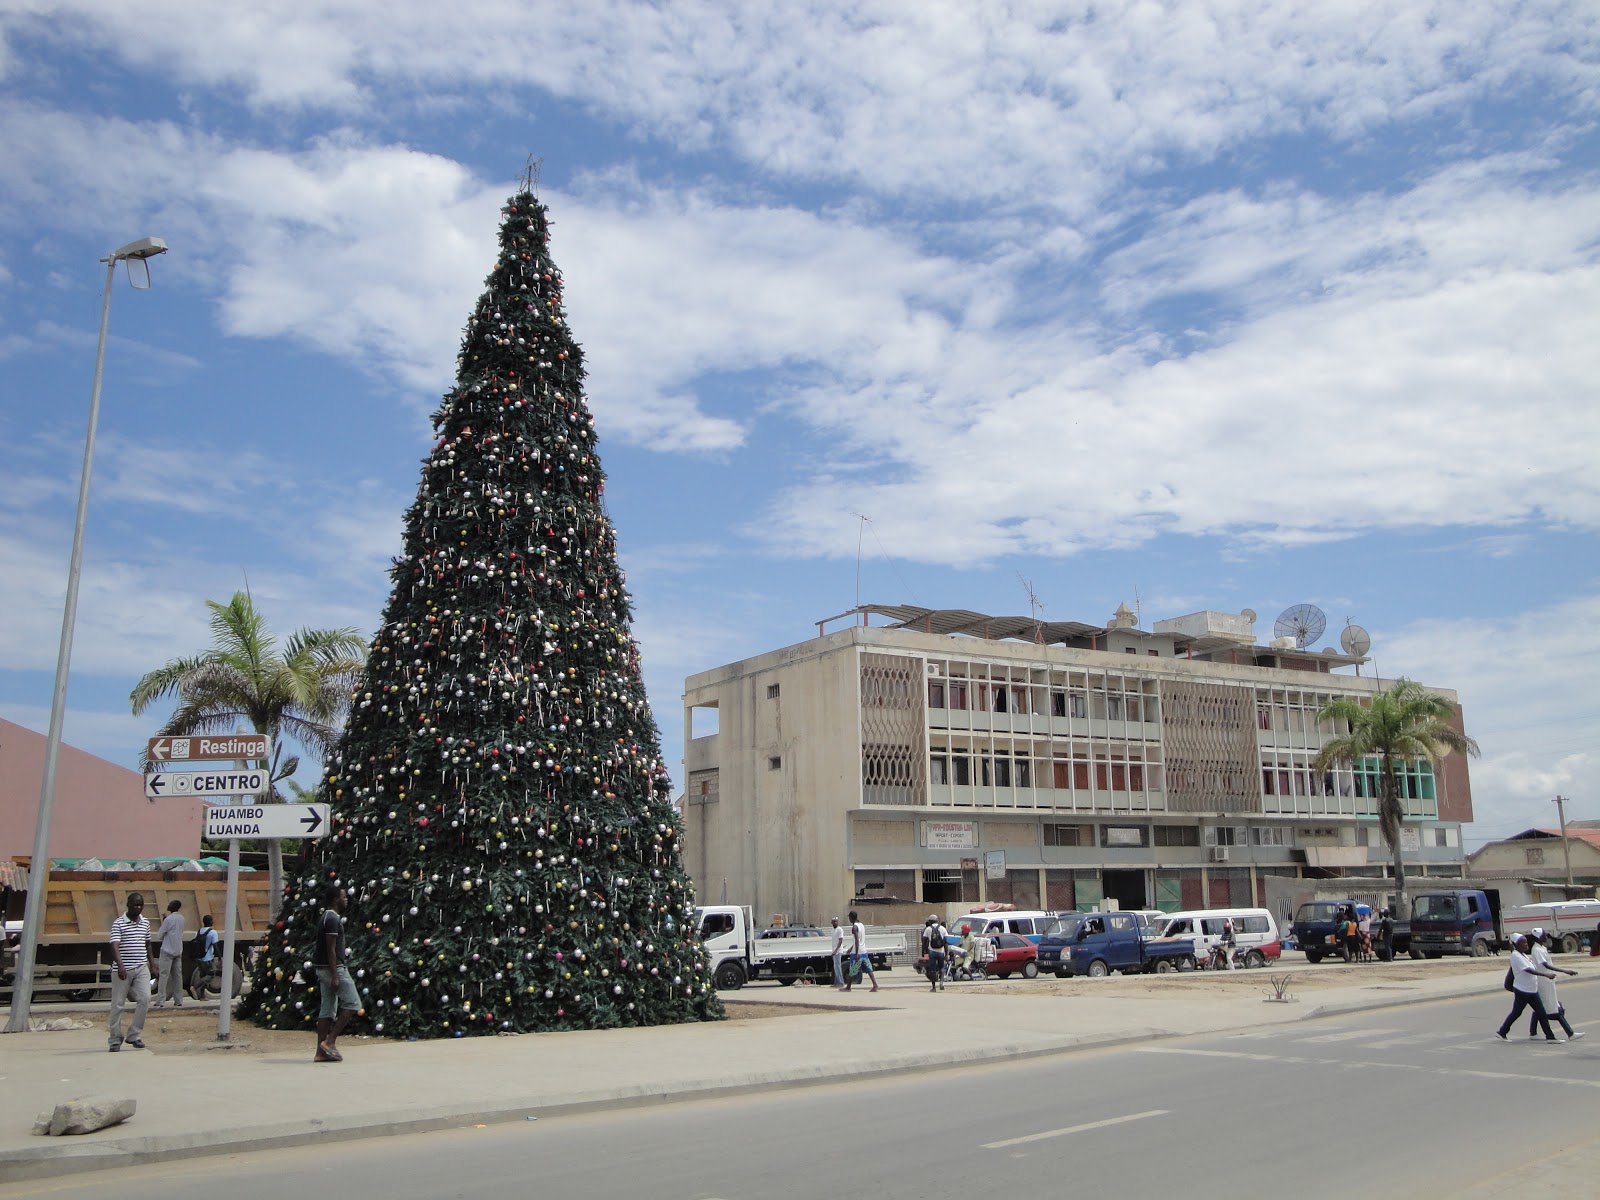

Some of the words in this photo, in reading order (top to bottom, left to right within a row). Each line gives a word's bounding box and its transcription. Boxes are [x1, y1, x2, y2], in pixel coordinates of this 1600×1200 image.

[199, 739, 265, 757] Restinga
[194, 775, 261, 790] CENTRO
[210, 808, 264, 820] HUAMBO
[209, 824, 260, 835] LUANDA
